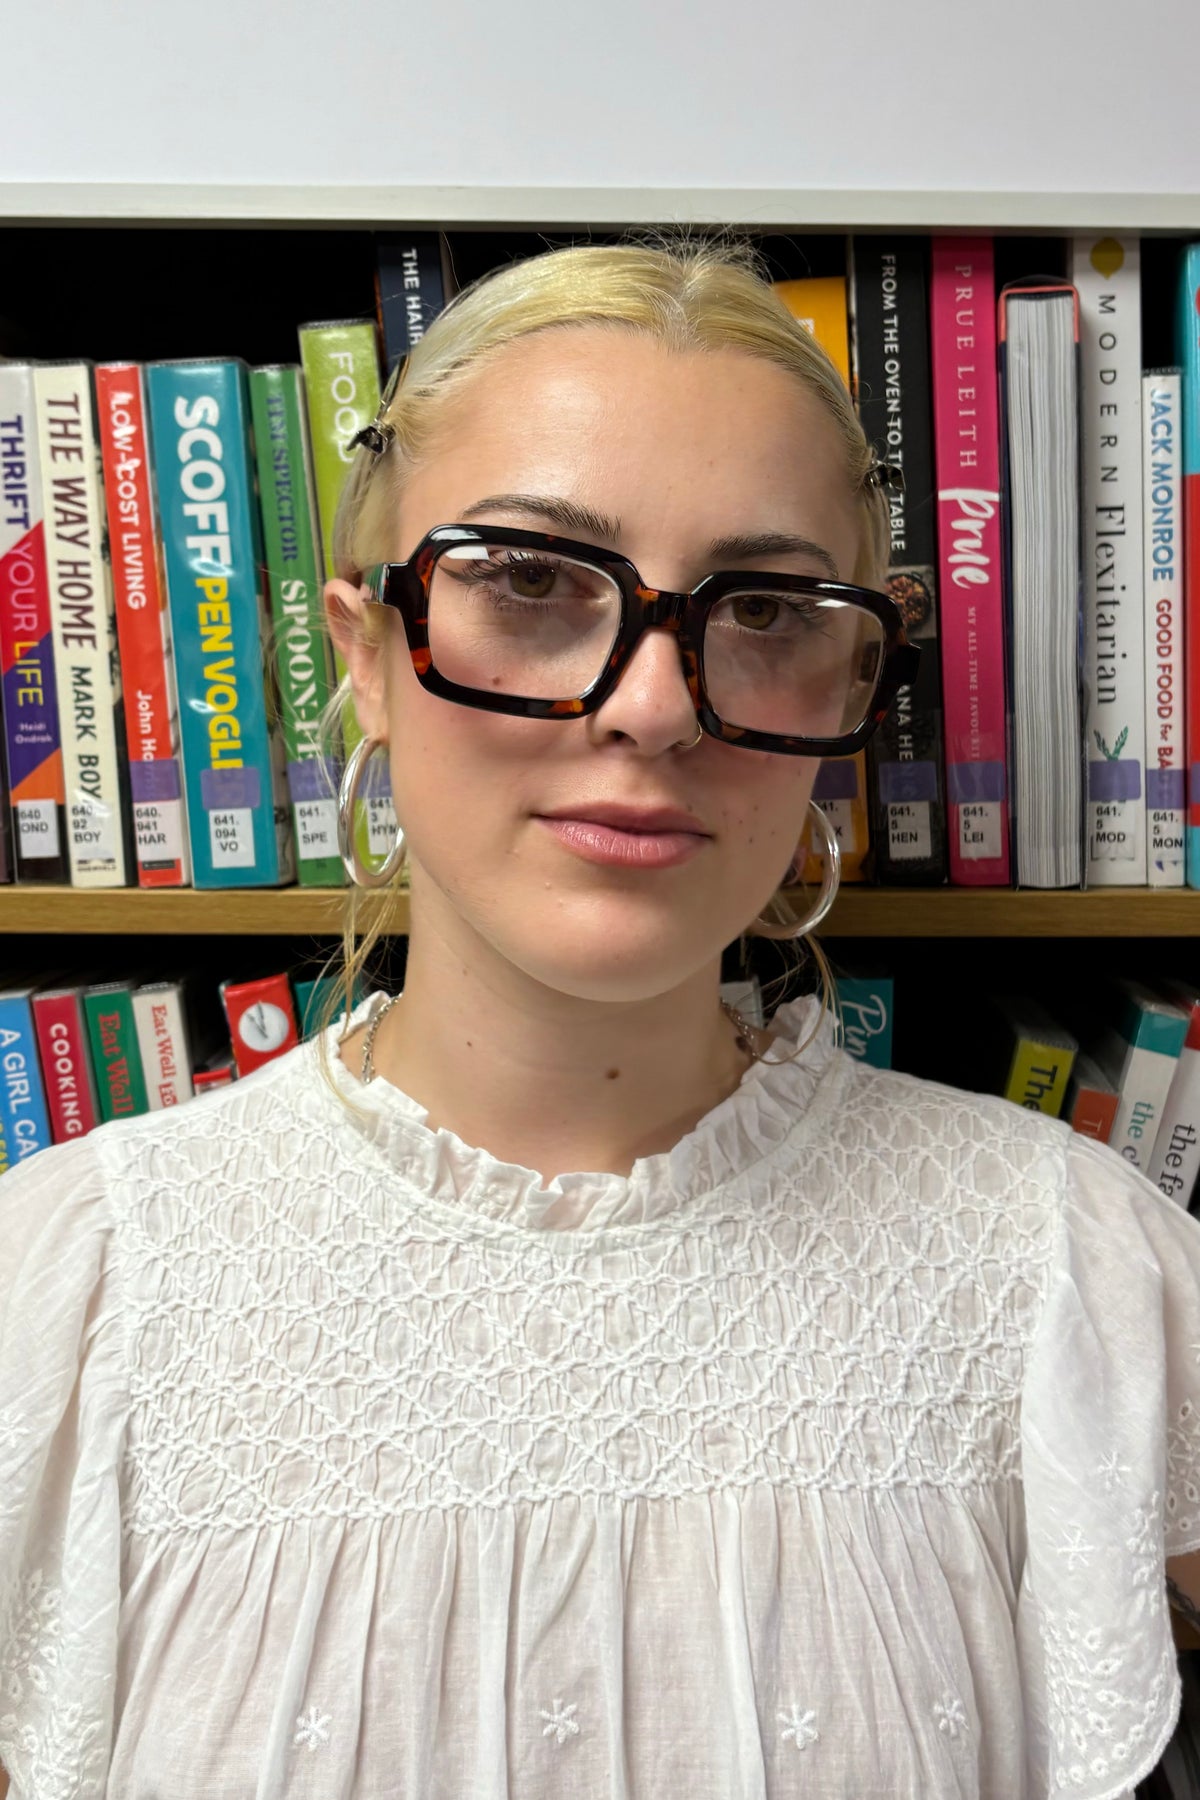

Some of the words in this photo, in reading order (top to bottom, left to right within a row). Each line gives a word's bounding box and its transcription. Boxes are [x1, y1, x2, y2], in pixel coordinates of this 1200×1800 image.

[401, 247, 421, 289] THE
[881, 253, 898, 311] FROM
[954, 264, 975, 351] PRUE
[883, 314, 899, 355] THE
[884, 358, 901, 414] OVEN
[1098, 294, 1118, 484] MODERN
[47, 393, 84, 465] THE
[886, 417, 903, 447] TO
[957, 365, 979, 468] LEITH
[1150, 388, 1173, 455] JACK
[0, 414, 30, 530] THRIFT
[110, 391, 140, 524] LOW-COST
[174, 395, 233, 568] SCOFF
[52, 477, 91, 550] WAY
[273, 448, 299, 563] SPECTOR
[889, 493, 906, 552] TABLE
[1151, 462, 1174, 582] MONROE
[8, 541, 37, 632] YOUR
[122, 532, 147, 611] LIVING
[57, 559, 98, 650] HOME
[195, 578, 235, 652] PEN
[1095, 503, 1128, 705] Flexitarian
[1155, 599, 1172, 659] GOOD
[14, 641, 44, 707] LIFE
[968, 629, 979, 691] ALL-TIME
[71, 666, 98, 742] MARK
[136, 690, 155, 735] John
[1156, 663, 1173, 720] FOOD
[20, 821, 49, 833] OND
[74, 831, 102, 844] BOY
[136, 820, 158, 832] 941
[213, 813, 240, 826] 641.
[214, 827, 237, 840] 094
[299, 806, 326, 818] 641.
[302, 831, 328, 844] SPE
[889, 805, 916, 818] 641.
[891, 831, 919, 844] HEN
[962, 805, 988, 818] 641.
[1095, 805, 1122, 818] 641.
[1095, 831, 1127, 844] MOD
[1152, 811, 1179, 823] 641.
[138, 832, 167, 845] HAR
[219, 841, 239, 854] VO
[963, 832, 985, 844] LEI
[1152, 836, 1184, 849] MON
[0, 1028, 22, 1047] A
[98, 1013, 121, 1057] Eat
[151, 1003, 169, 1036] Eat
[4, 1052, 32, 1115] GIRL
[50, 1023, 83, 1134] COOKING
[157, 1035, 179, 1080] Well
[104, 1056, 135, 1116] Well
[1127, 1100, 1155, 1140] the
[1164, 1123, 1198, 1171] the
